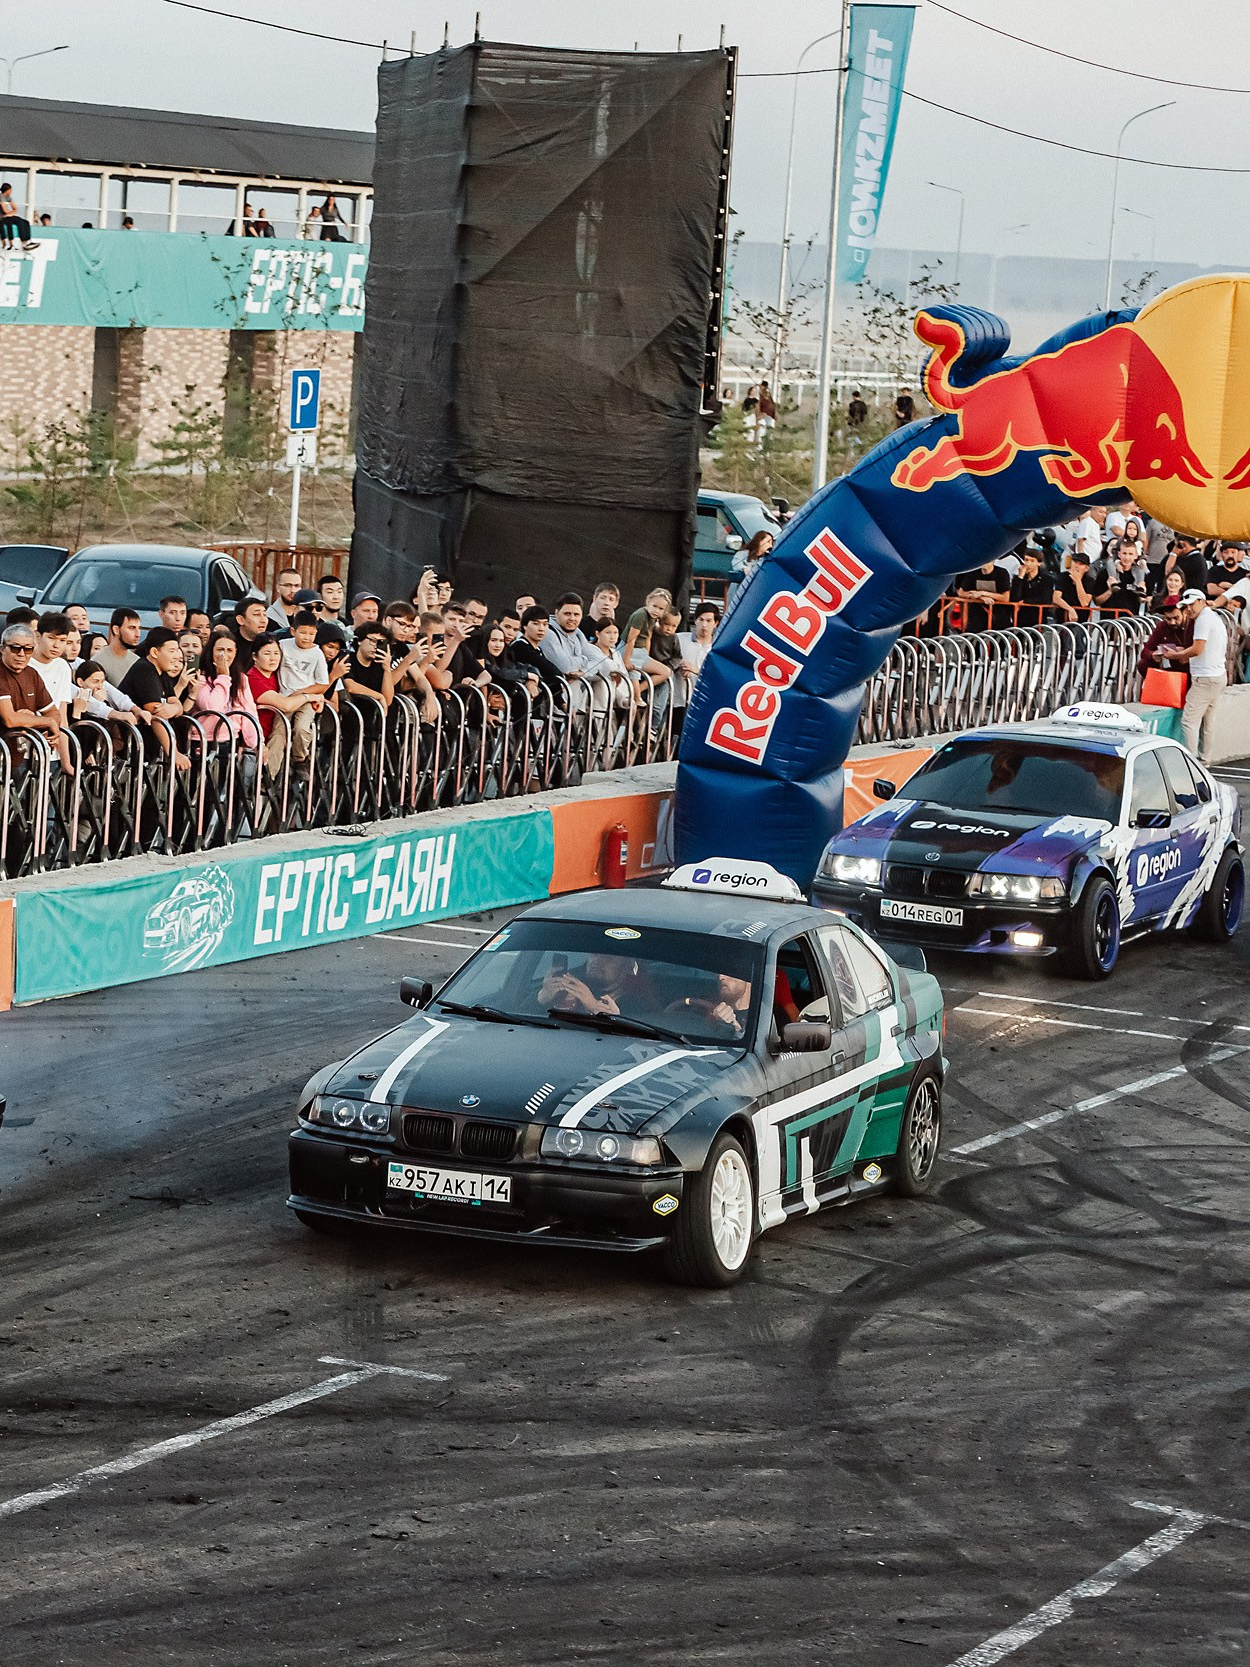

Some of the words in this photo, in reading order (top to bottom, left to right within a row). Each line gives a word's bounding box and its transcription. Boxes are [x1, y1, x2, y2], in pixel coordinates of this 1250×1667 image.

[295, 375, 314, 424] P
[704, 629, 804, 766] Red
[757, 526, 874, 657] Bull
[1081, 709, 1120, 721] region
[937, 823, 1010, 837] region
[1149, 845, 1181, 882] region
[253, 833, 457, 946] ЕРТІС-БАЯН
[713, 873, 768, 888] region
[389, 1177, 401, 1187] KZ
[484, 1179, 509, 1200] 14
[657, 1201, 675, 1209] YACCO
